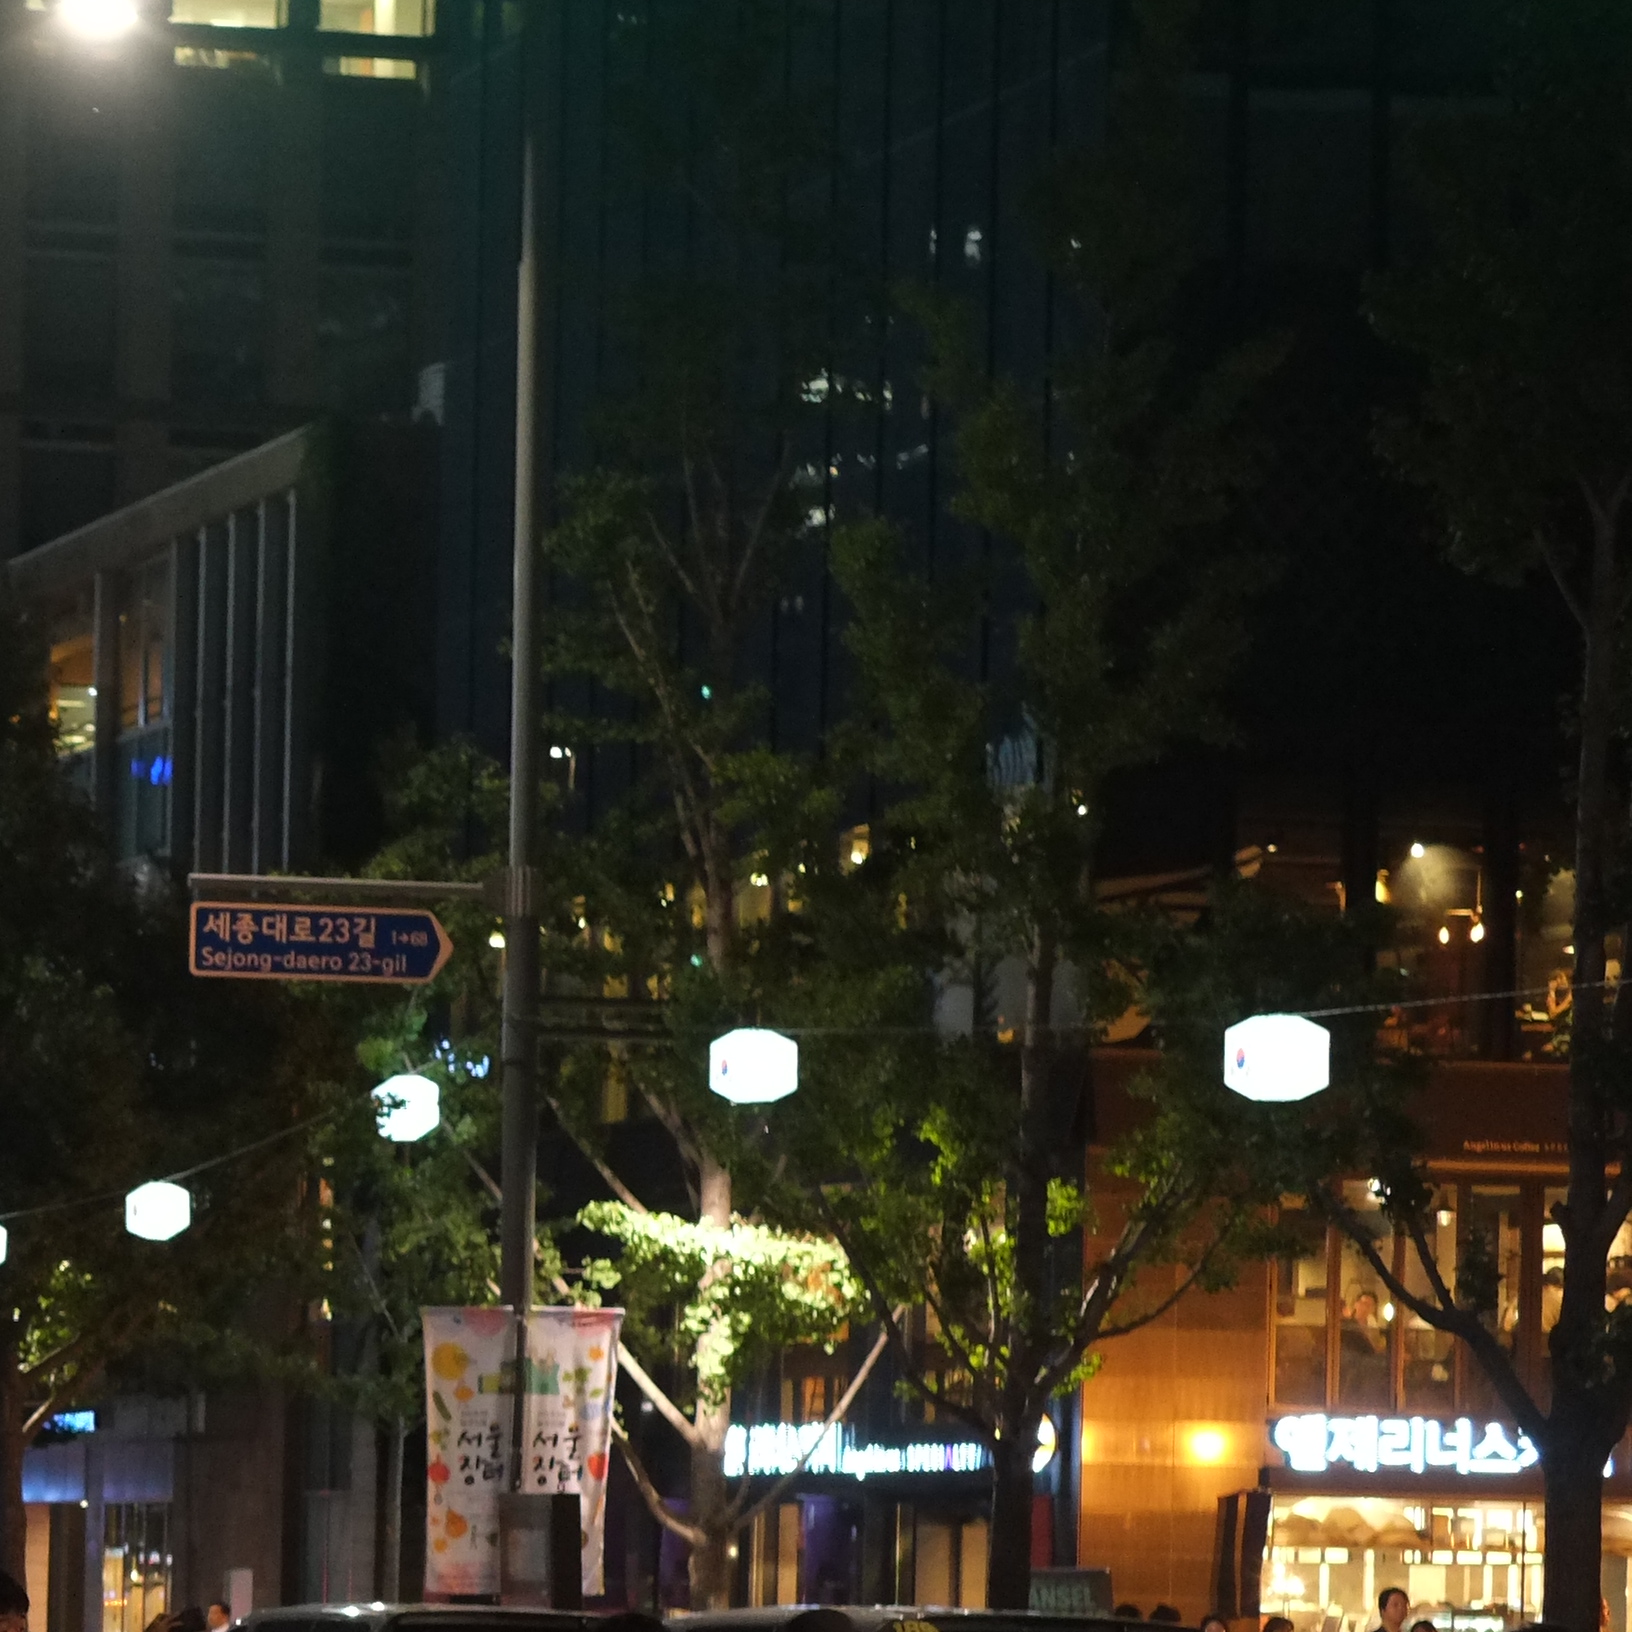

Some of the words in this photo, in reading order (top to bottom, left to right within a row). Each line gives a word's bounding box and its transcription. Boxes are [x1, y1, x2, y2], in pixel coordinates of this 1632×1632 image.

[203, 911, 377, 949] 세종대로23길
[201, 946, 342, 972] Sejong-daero
[347, 951, 408, 976] 23-gil
